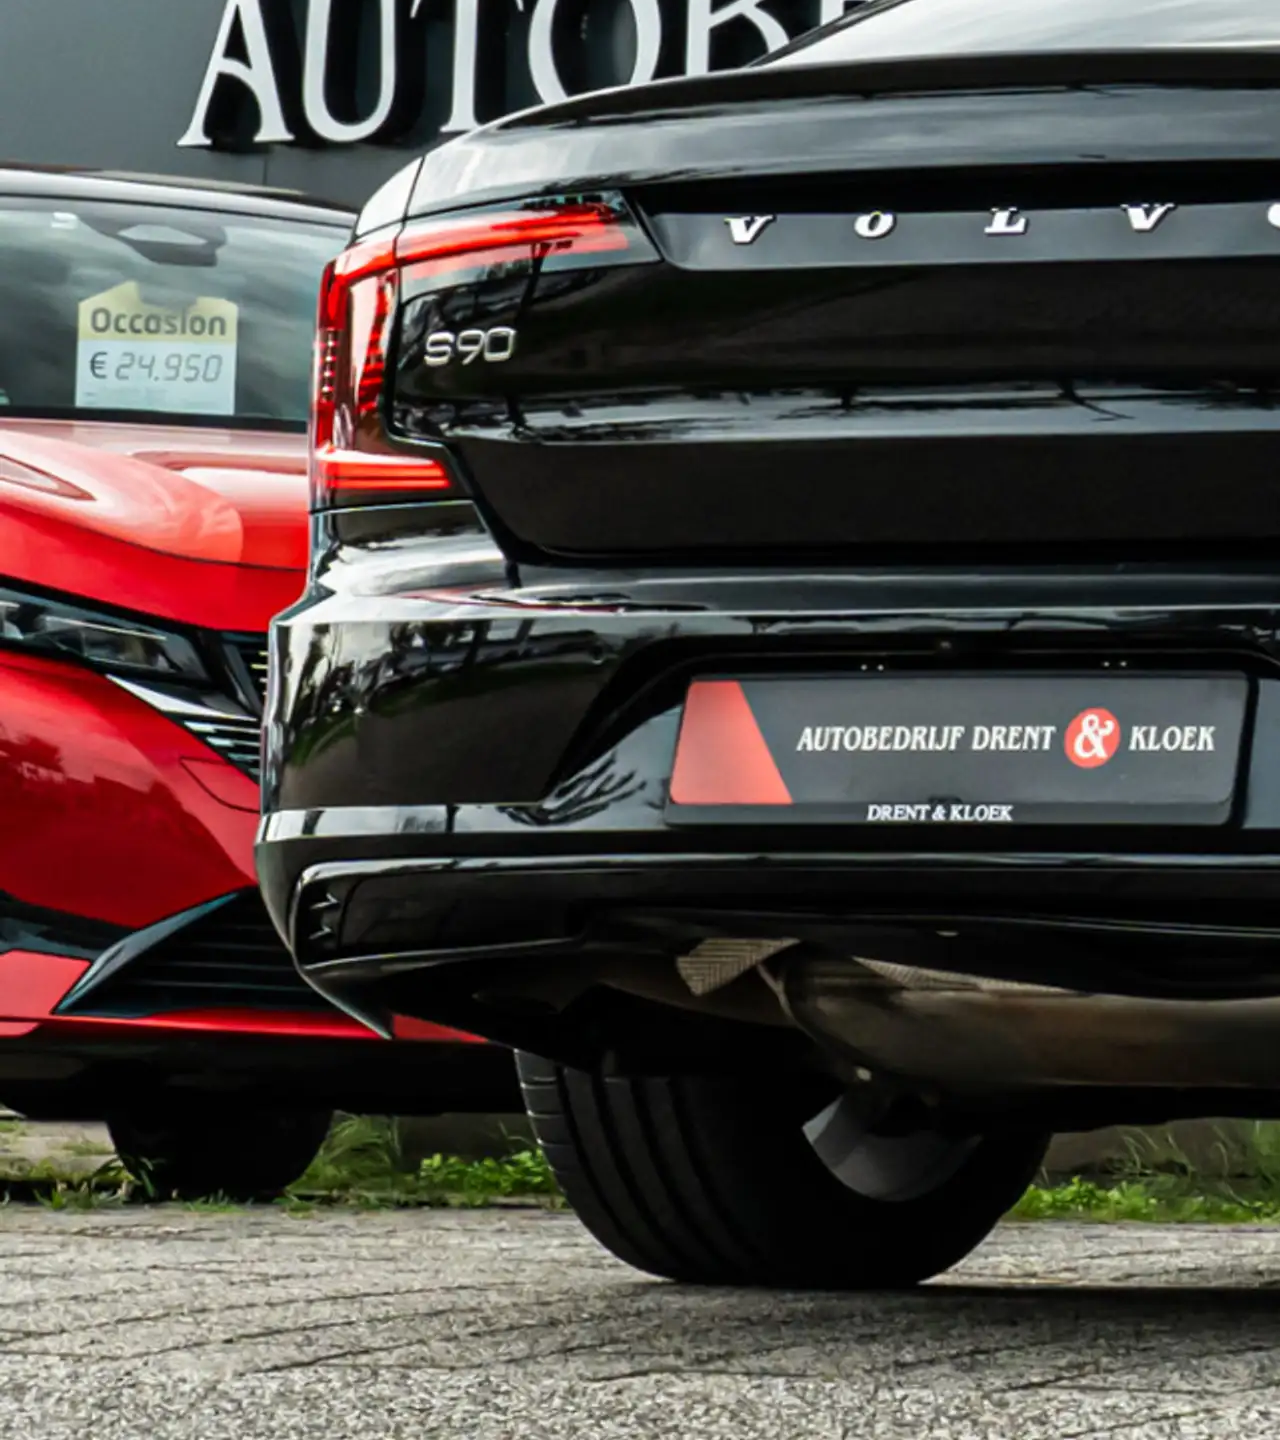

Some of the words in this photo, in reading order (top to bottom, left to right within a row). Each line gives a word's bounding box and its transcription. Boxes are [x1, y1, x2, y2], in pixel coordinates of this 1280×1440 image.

[90, 307, 227, 336] Occasion
[424, 326, 517, 367] S90
[797, 725, 965, 752] AUTOBEDRIJF
[971, 725, 1056, 752] DRENT
[1074, 713, 1115, 760] &
[1128, 725, 1216, 752] KLOEK
[867, 804, 930, 822] DRENT
[932, 805, 946, 821] &
[949, 804, 1013, 822] KLOEK
